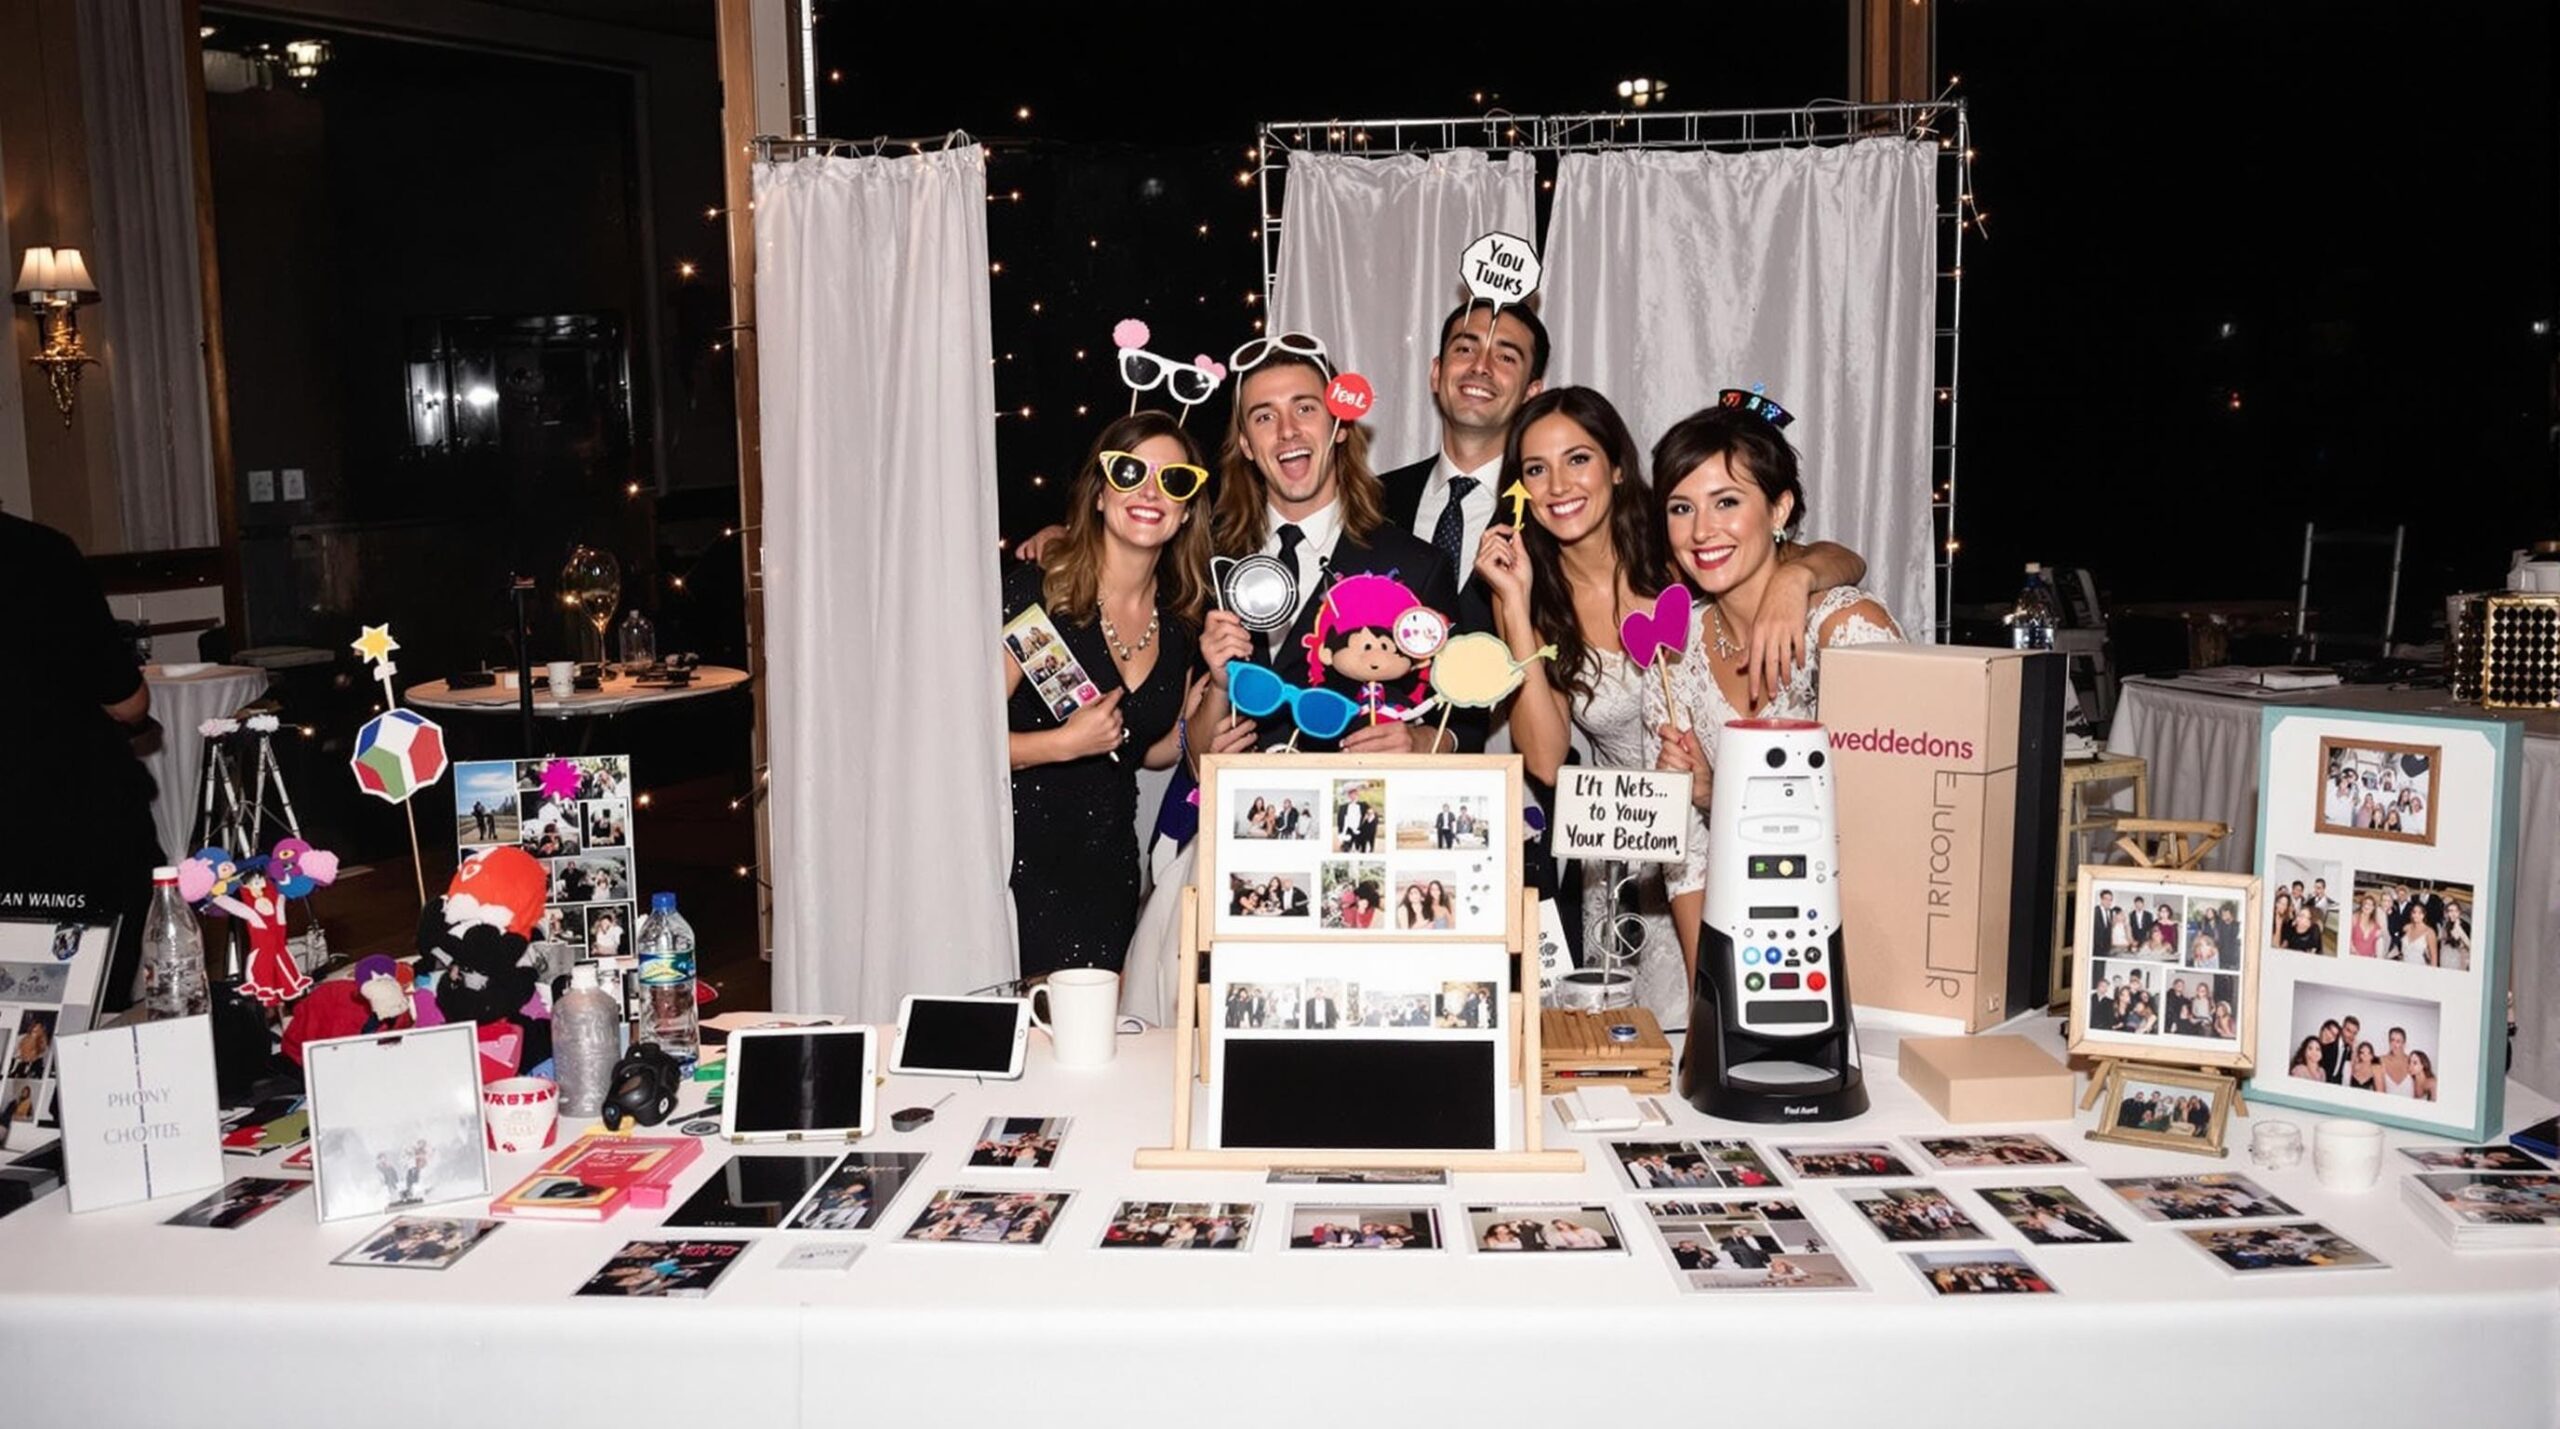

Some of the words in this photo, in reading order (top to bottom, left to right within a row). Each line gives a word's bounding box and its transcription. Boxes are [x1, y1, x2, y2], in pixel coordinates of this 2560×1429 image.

[1828, 727, 1974, 760] weddedons
[1589, 803, 1606, 821] to
[0, 892, 23, 907] AN
[28, 892, 86, 908] WAINGS
